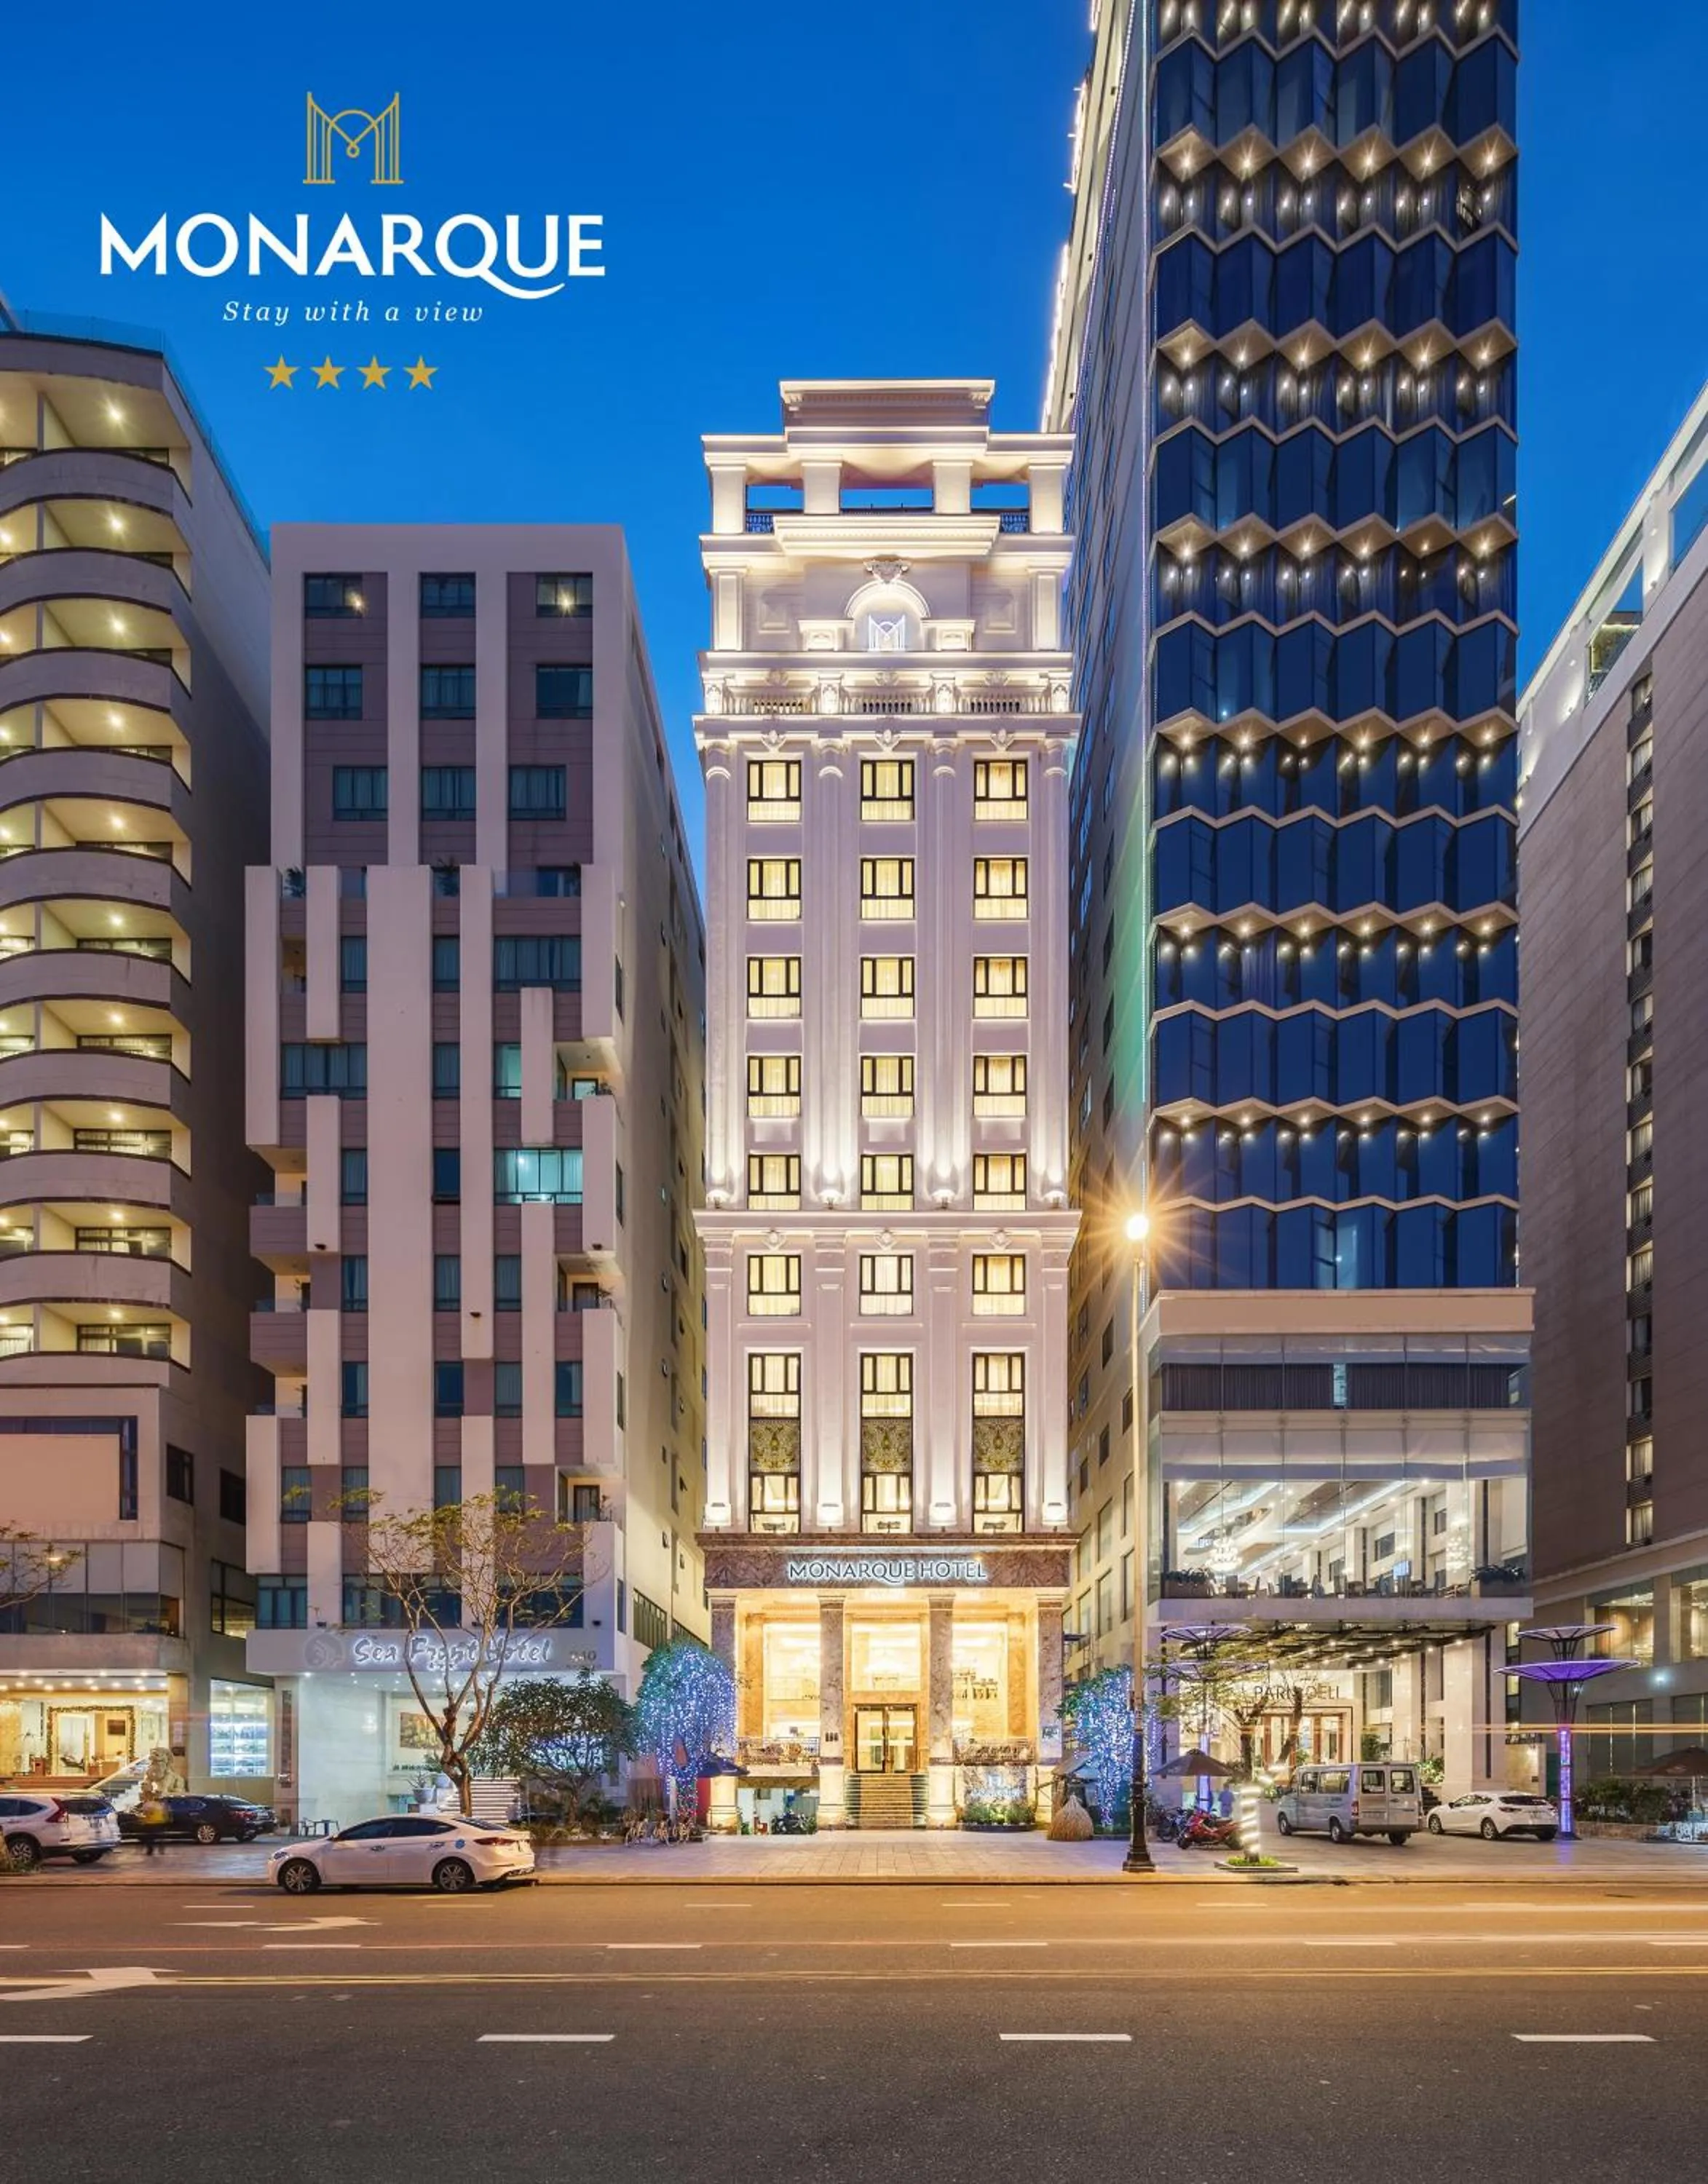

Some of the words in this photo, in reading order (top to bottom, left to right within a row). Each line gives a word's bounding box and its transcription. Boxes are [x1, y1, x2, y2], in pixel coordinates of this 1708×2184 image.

[789, 1562, 913, 1583] MONARQUE
[920, 1562, 987, 1578] HOTEL
[354, 1638, 398, 1663] Sea
[486, 1637, 551, 1663] Hotel
